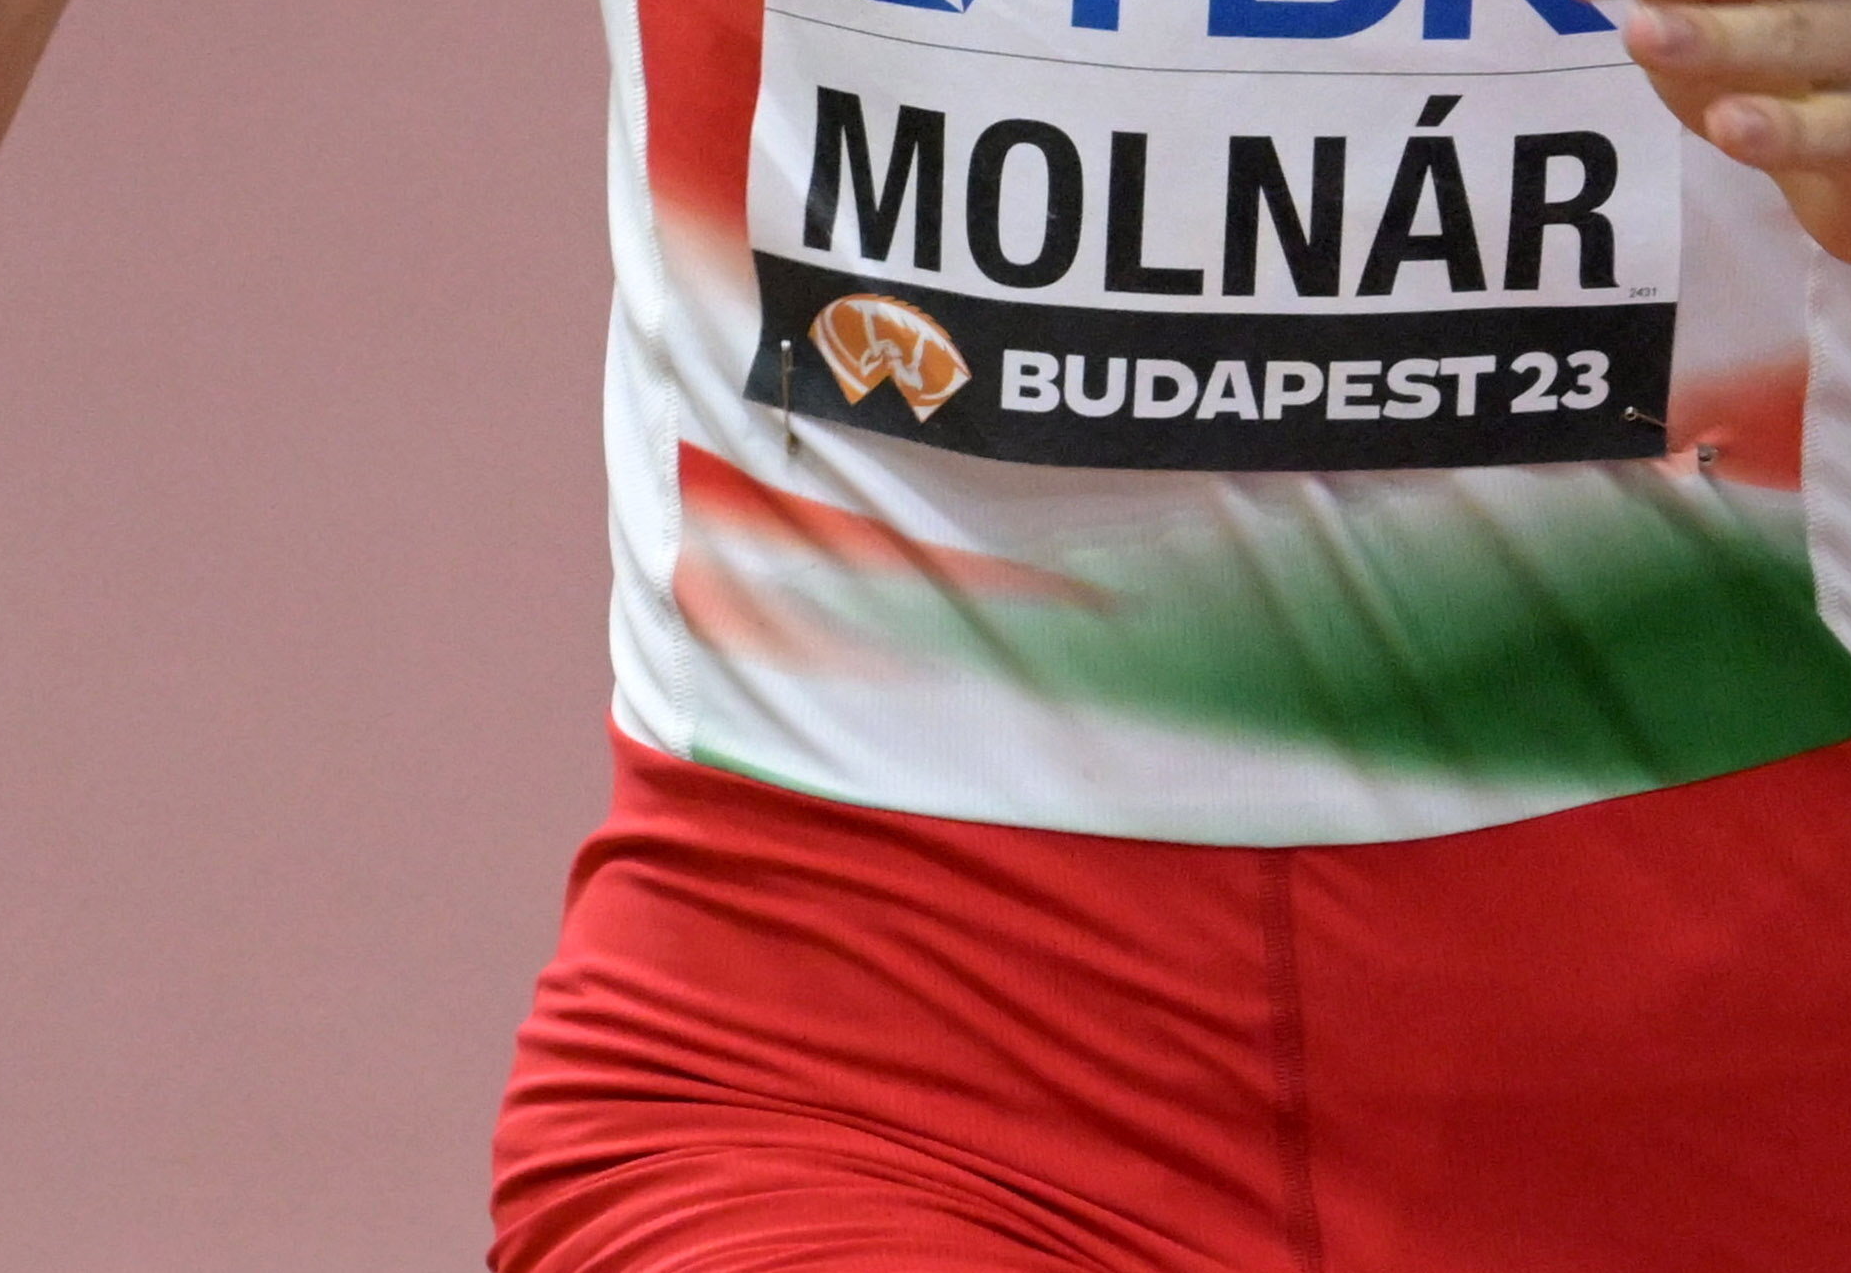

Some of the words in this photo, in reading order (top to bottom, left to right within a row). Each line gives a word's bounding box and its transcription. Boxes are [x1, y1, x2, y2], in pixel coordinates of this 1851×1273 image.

[801, 85, 1621, 298] MOLNÁR
[1001, 349, 1497, 420] BUDAPEST
[1509, 350, 1610, 413] 23
